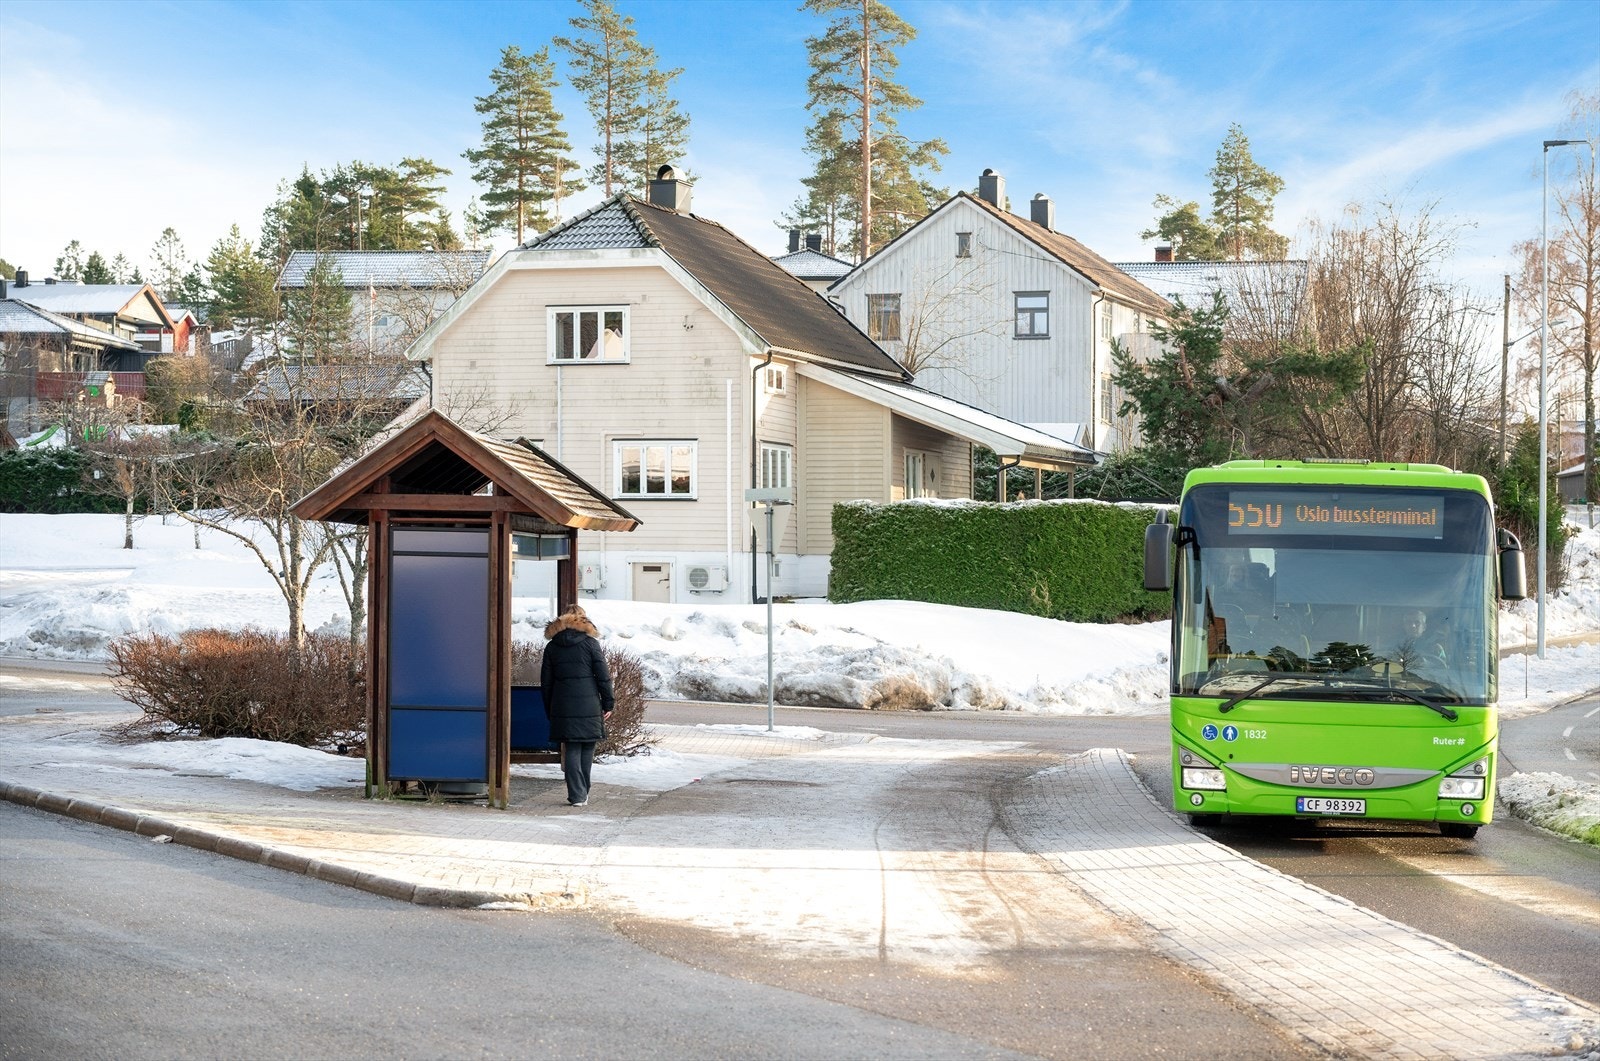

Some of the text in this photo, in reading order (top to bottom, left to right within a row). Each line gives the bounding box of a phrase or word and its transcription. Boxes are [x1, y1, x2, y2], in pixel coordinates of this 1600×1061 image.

[1296, 505, 1330, 522] Oslo
[1333, 506, 1436, 525] bussterminal
[1244, 730, 1267, 739] 1832
[1290, 766, 1375, 785] IVECO
[1306, 799, 1362, 811] CF 98392
